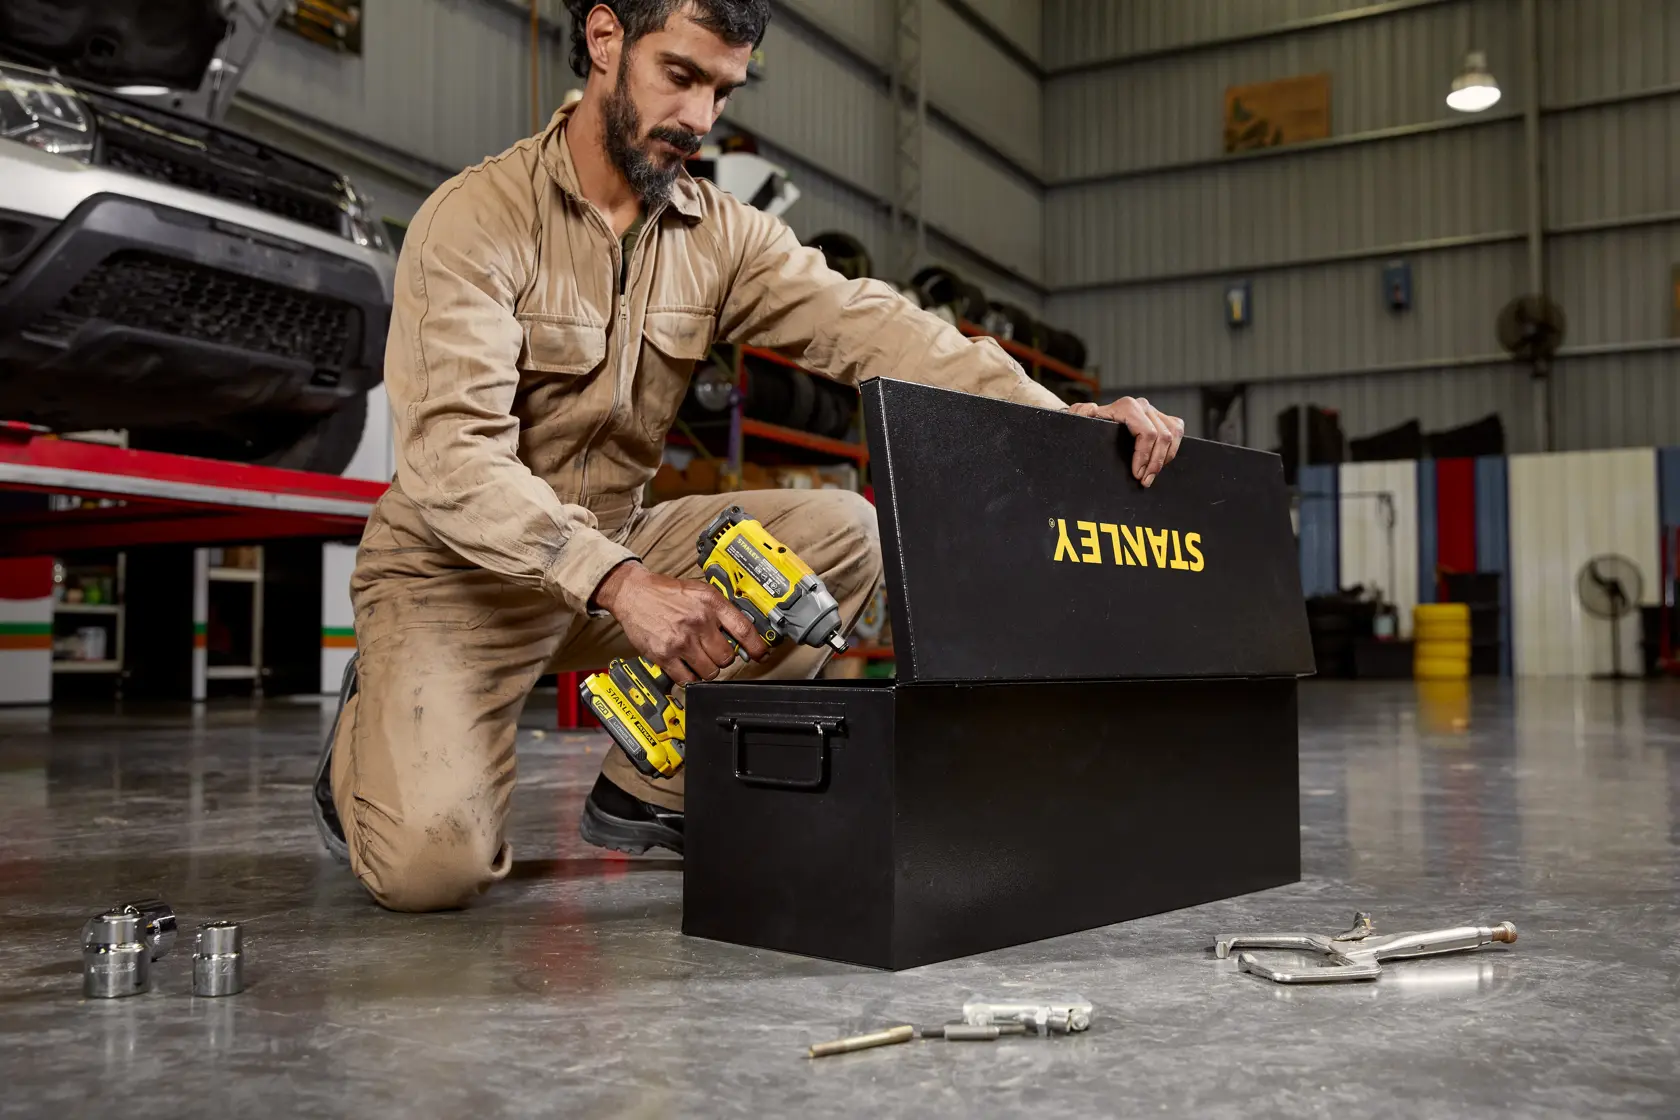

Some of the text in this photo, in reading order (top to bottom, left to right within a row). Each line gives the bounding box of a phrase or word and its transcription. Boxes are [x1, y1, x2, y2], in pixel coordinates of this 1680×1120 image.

[736, 538, 760, 561] STANLEY
[1053, 518, 1205, 572] STANLEY
[606, 687, 637, 720] STANLEY
